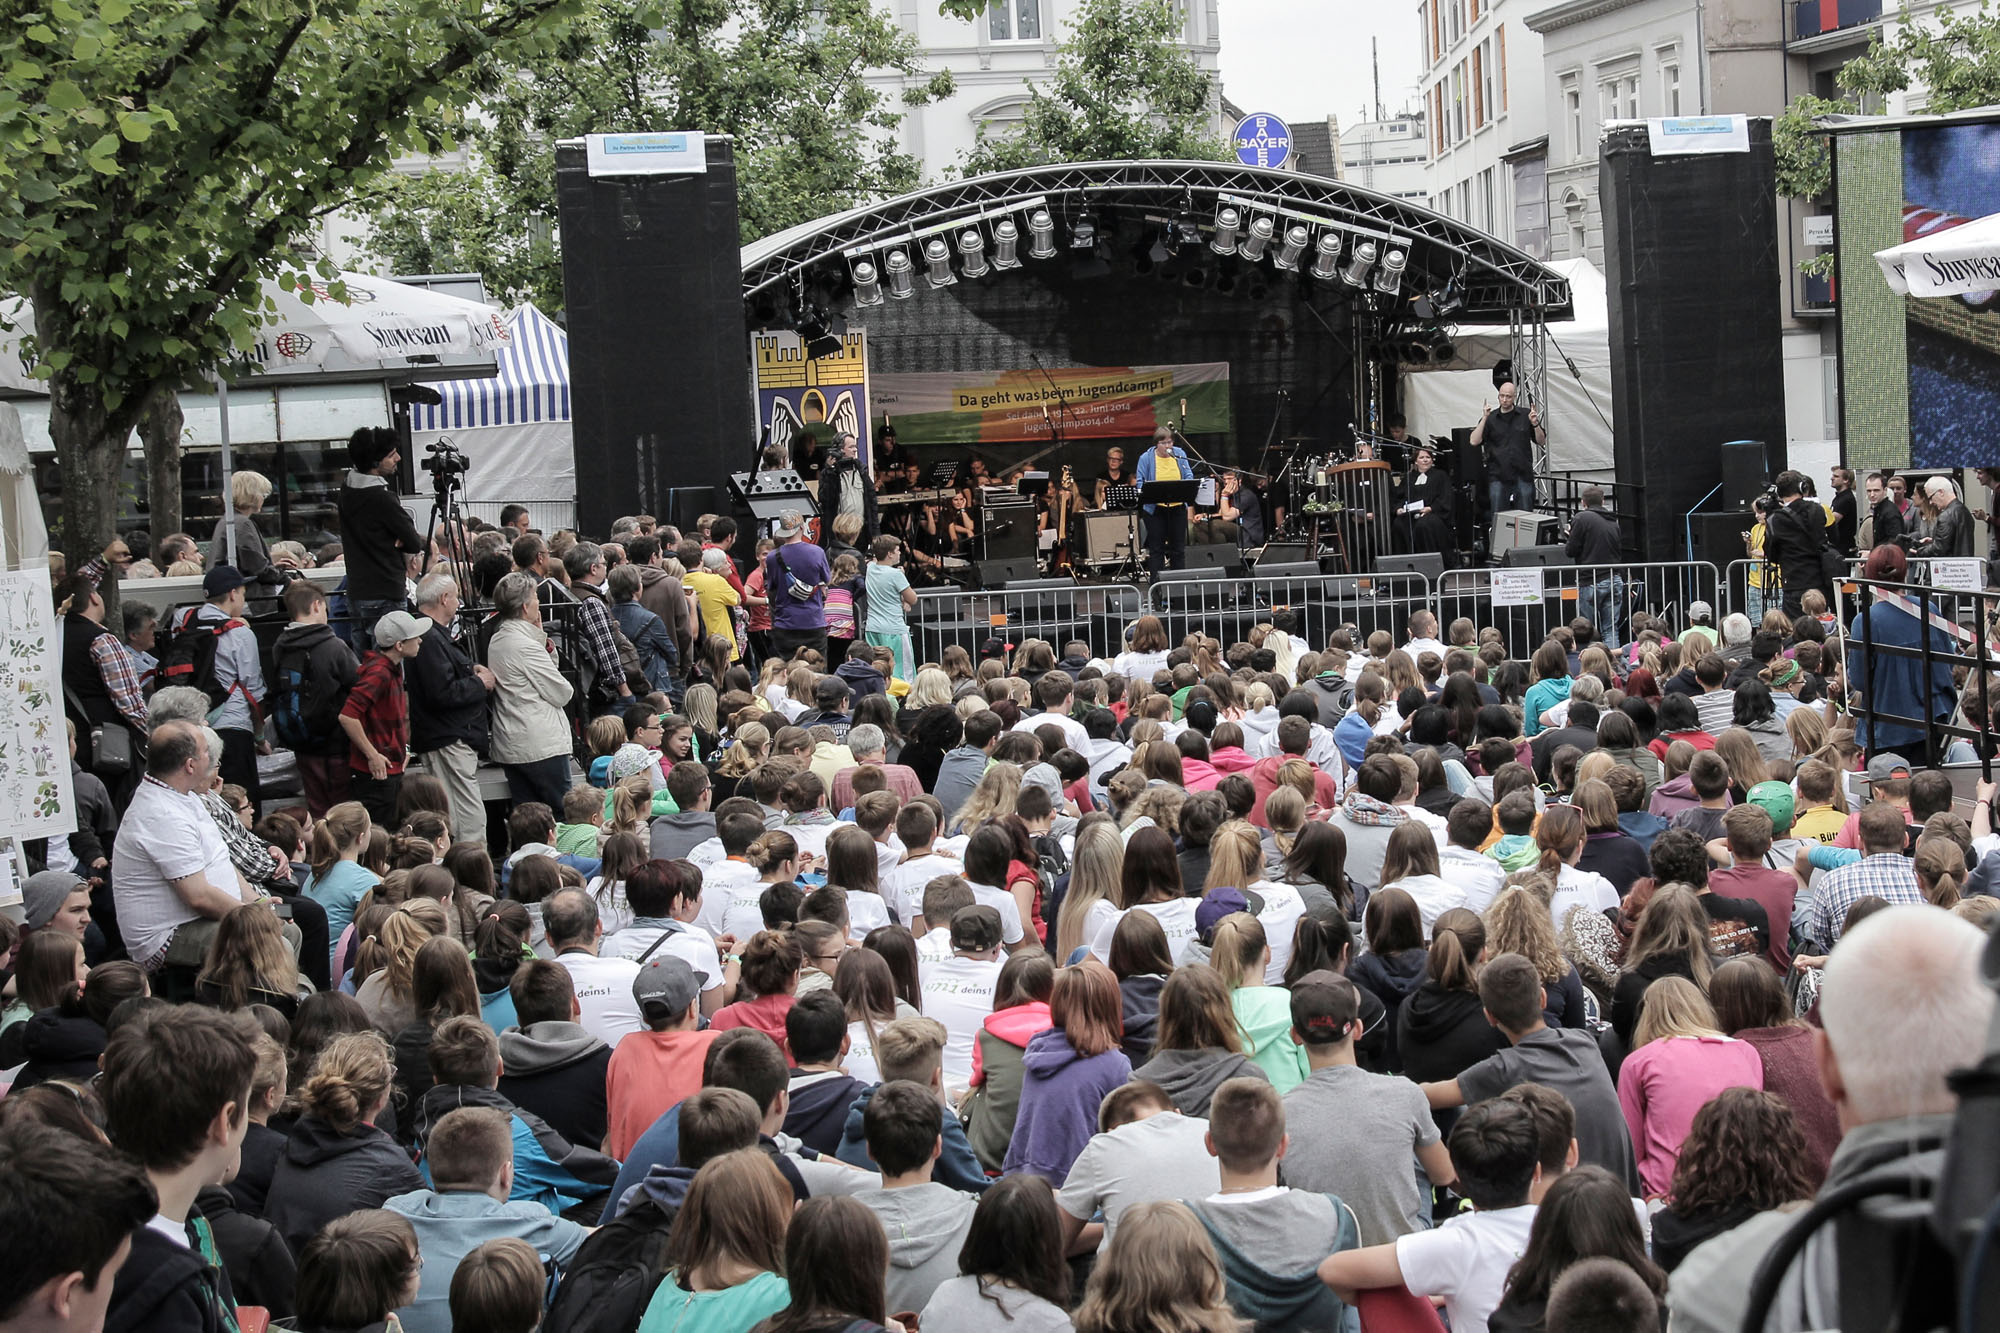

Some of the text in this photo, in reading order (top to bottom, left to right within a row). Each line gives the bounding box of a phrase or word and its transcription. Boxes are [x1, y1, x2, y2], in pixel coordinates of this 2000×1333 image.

[1237, 137, 1288, 149] BAYER
[1256, 117, 1269, 167] BAYER
[363, 321, 452, 353] Stuyvesant
[959, 395, 977, 407] Da
[981, 391, 1011, 408] geht
[1015, 390, 1040, 402] was
[1042, 386, 1074, 400] beim
[1090, 404, 1108, 414] Juni
[1111, 402, 1131, 412] 2014
[577, 985, 611, 999] deins!
[961, 984, 991, 996] deins!
